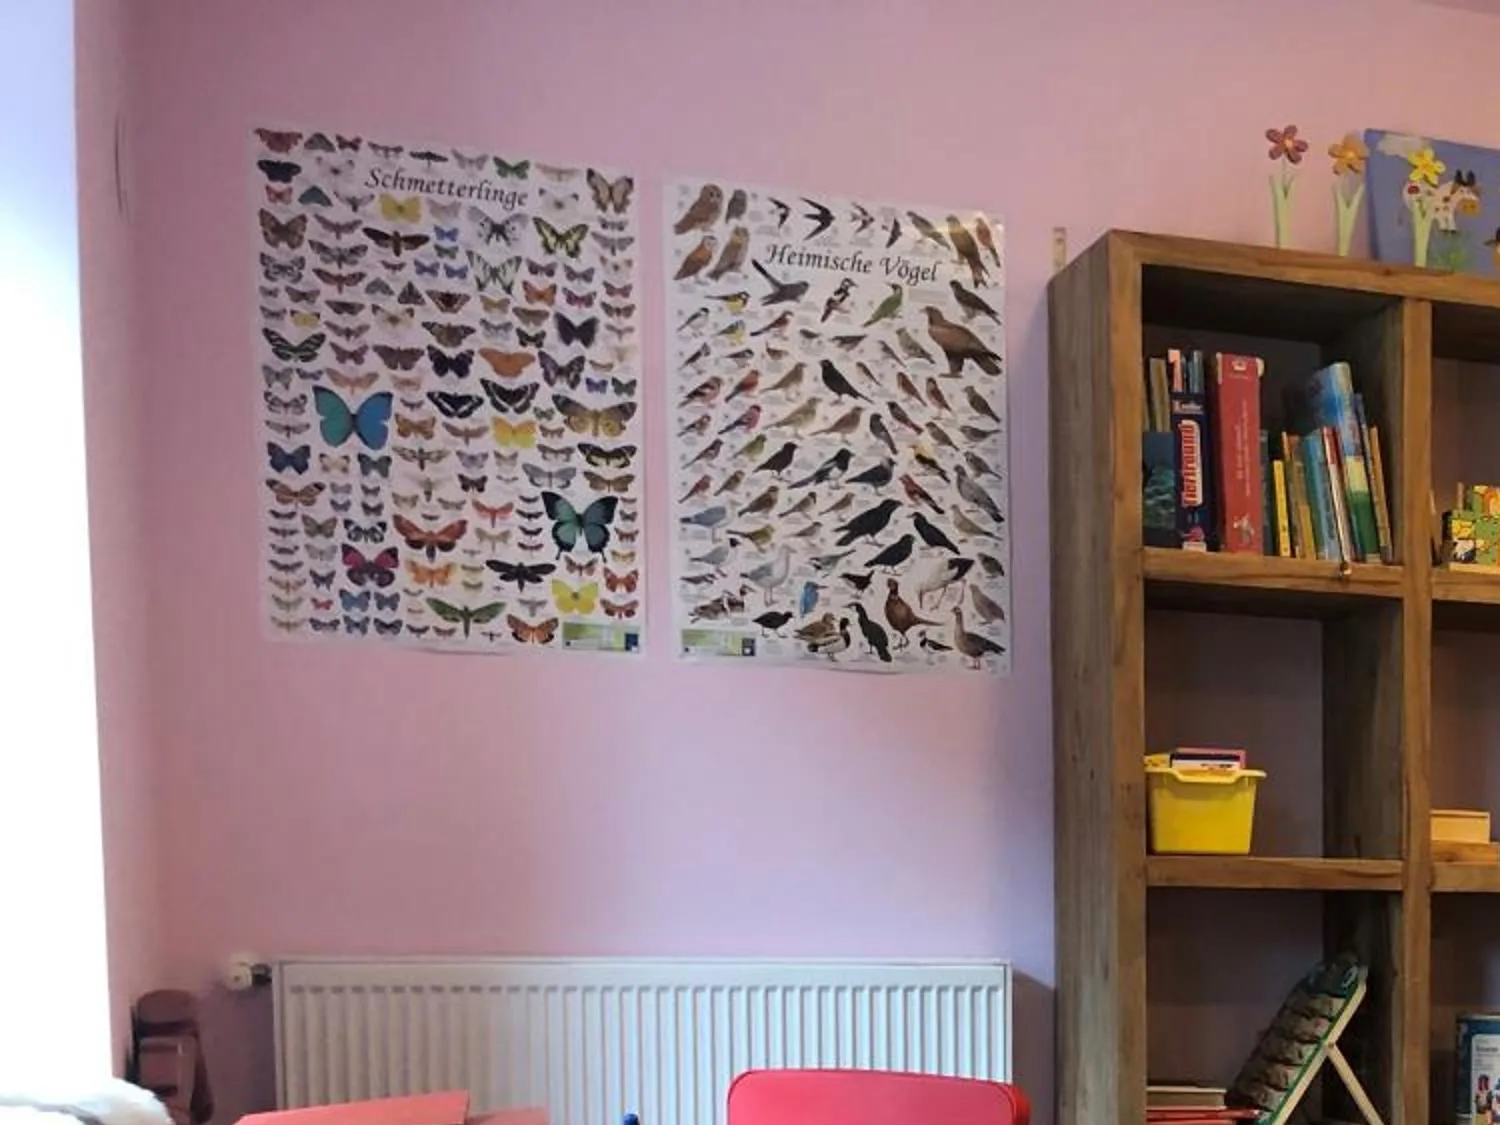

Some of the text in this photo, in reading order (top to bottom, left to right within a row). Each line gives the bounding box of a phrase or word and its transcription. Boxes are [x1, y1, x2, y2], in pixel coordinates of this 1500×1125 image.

[364, 166, 530, 211] Schmetterlinge
[765, 243, 943, 287] Heimische Vögel
